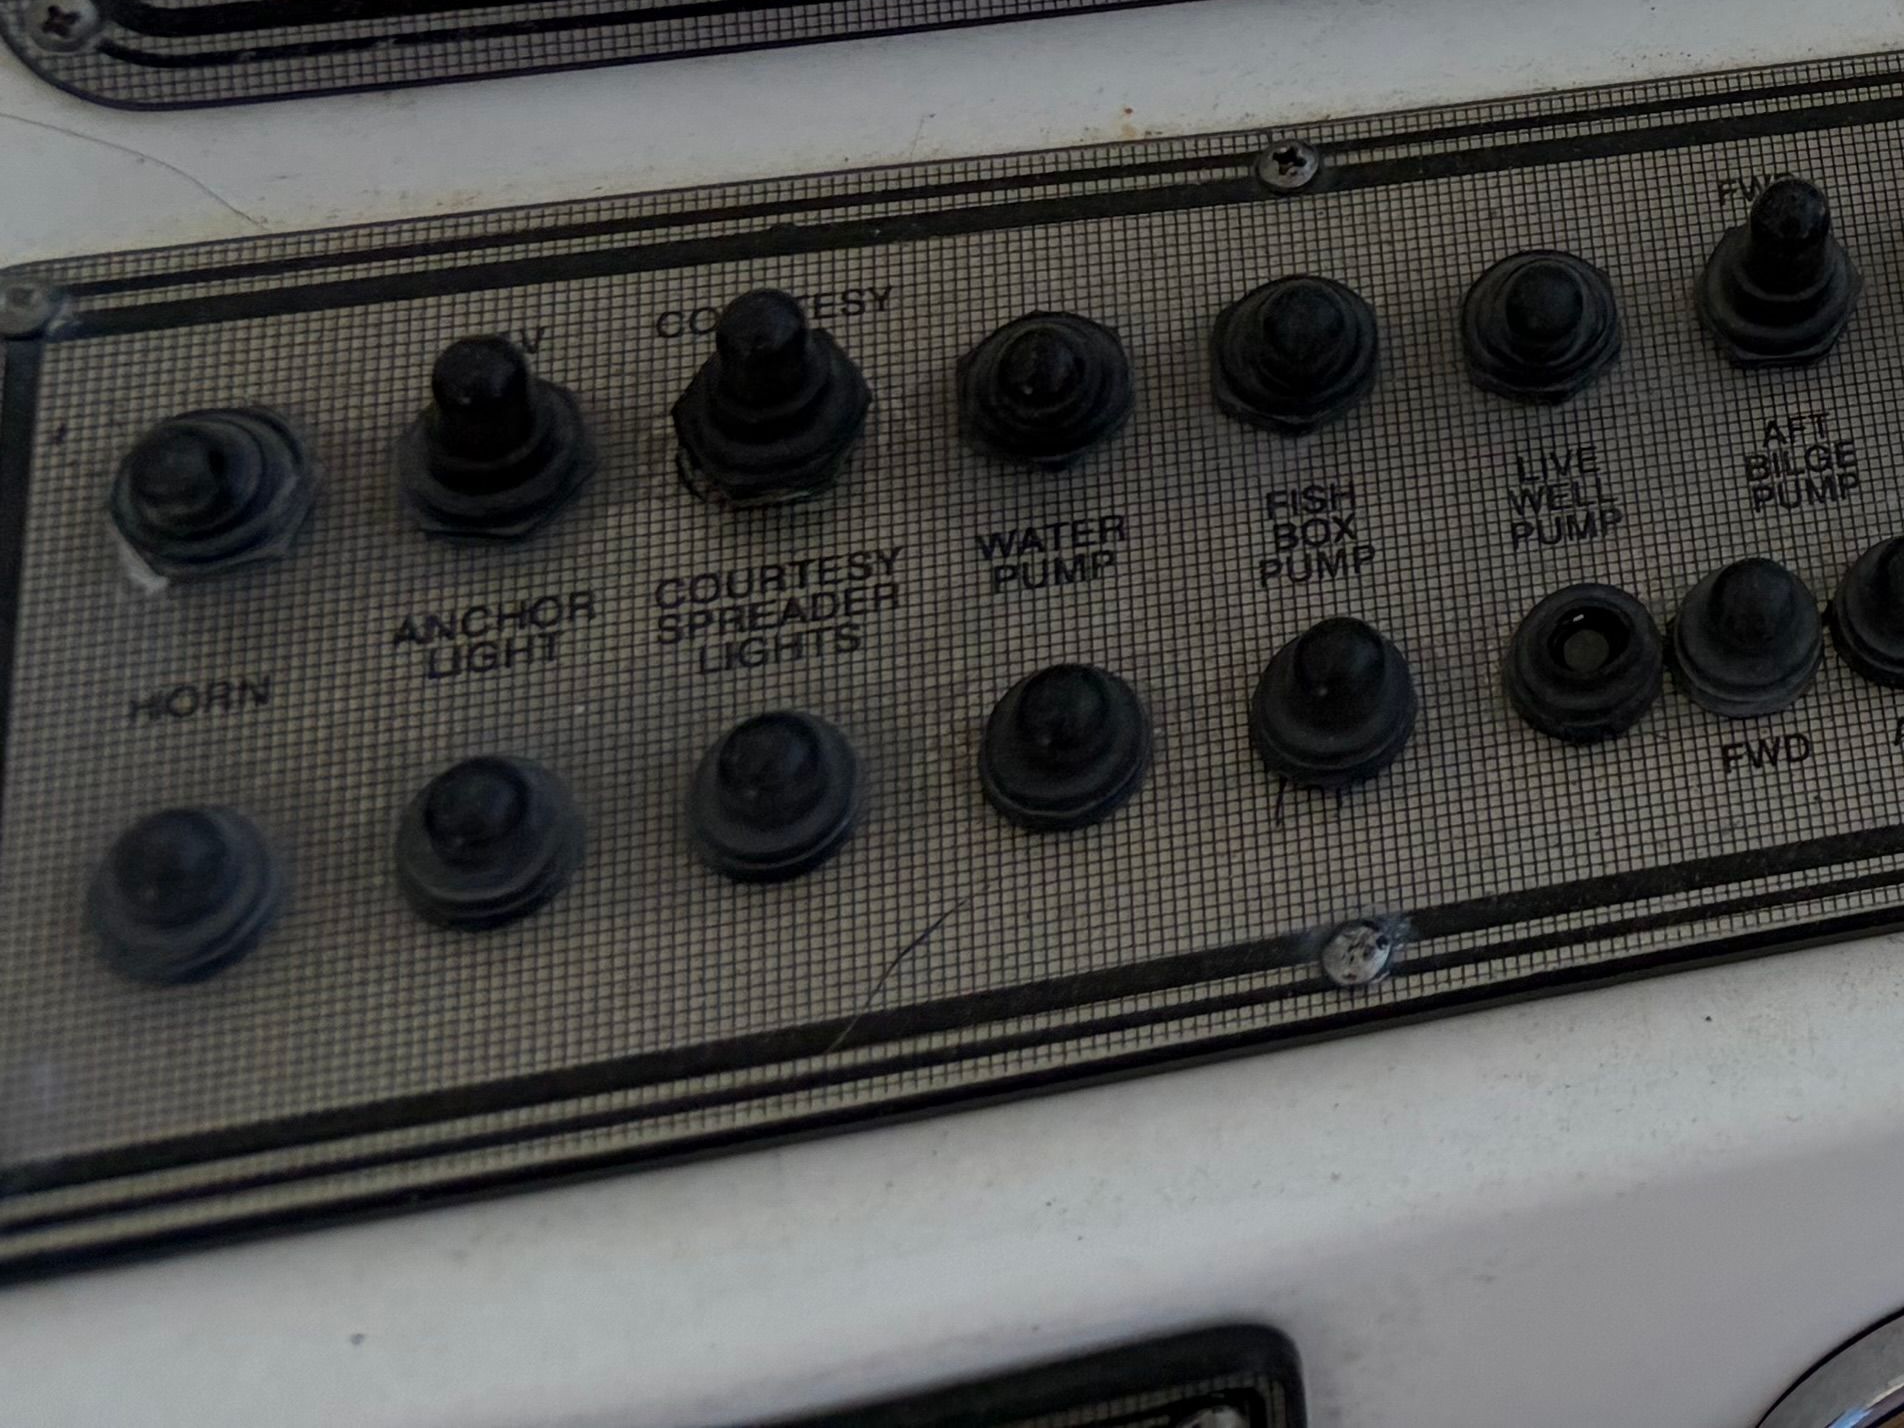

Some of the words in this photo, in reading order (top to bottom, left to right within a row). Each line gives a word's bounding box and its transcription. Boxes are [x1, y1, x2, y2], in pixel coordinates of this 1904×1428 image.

[1763, 412, 1831, 449] AFT
[1516, 445, 1599, 485] LIVE
[1744, 440, 1857, 481] BILGE
[1266, 481, 1356, 521] FISH
[1507, 478, 1618, 516] WELL
[1751, 472, 1862, 514] PUMP
[975, 514, 1125, 562] WATER
[1273, 514, 1358, 547] BOX
[1511, 508, 1625, 547] PUMP
[655, 544, 899, 609] COURTESY
[992, 550, 1118, 594] PUMP
[1259, 544, 1376, 588] PUMP
[394, 589, 598, 648] ANCHOR
[657, 581, 899, 644] SPREADER
[428, 631, 561, 679] LIGHT
[698, 623, 862, 676] LIGHTS
[130, 674, 271, 725] HORN
[1723, 734, 1811, 775] FWD
